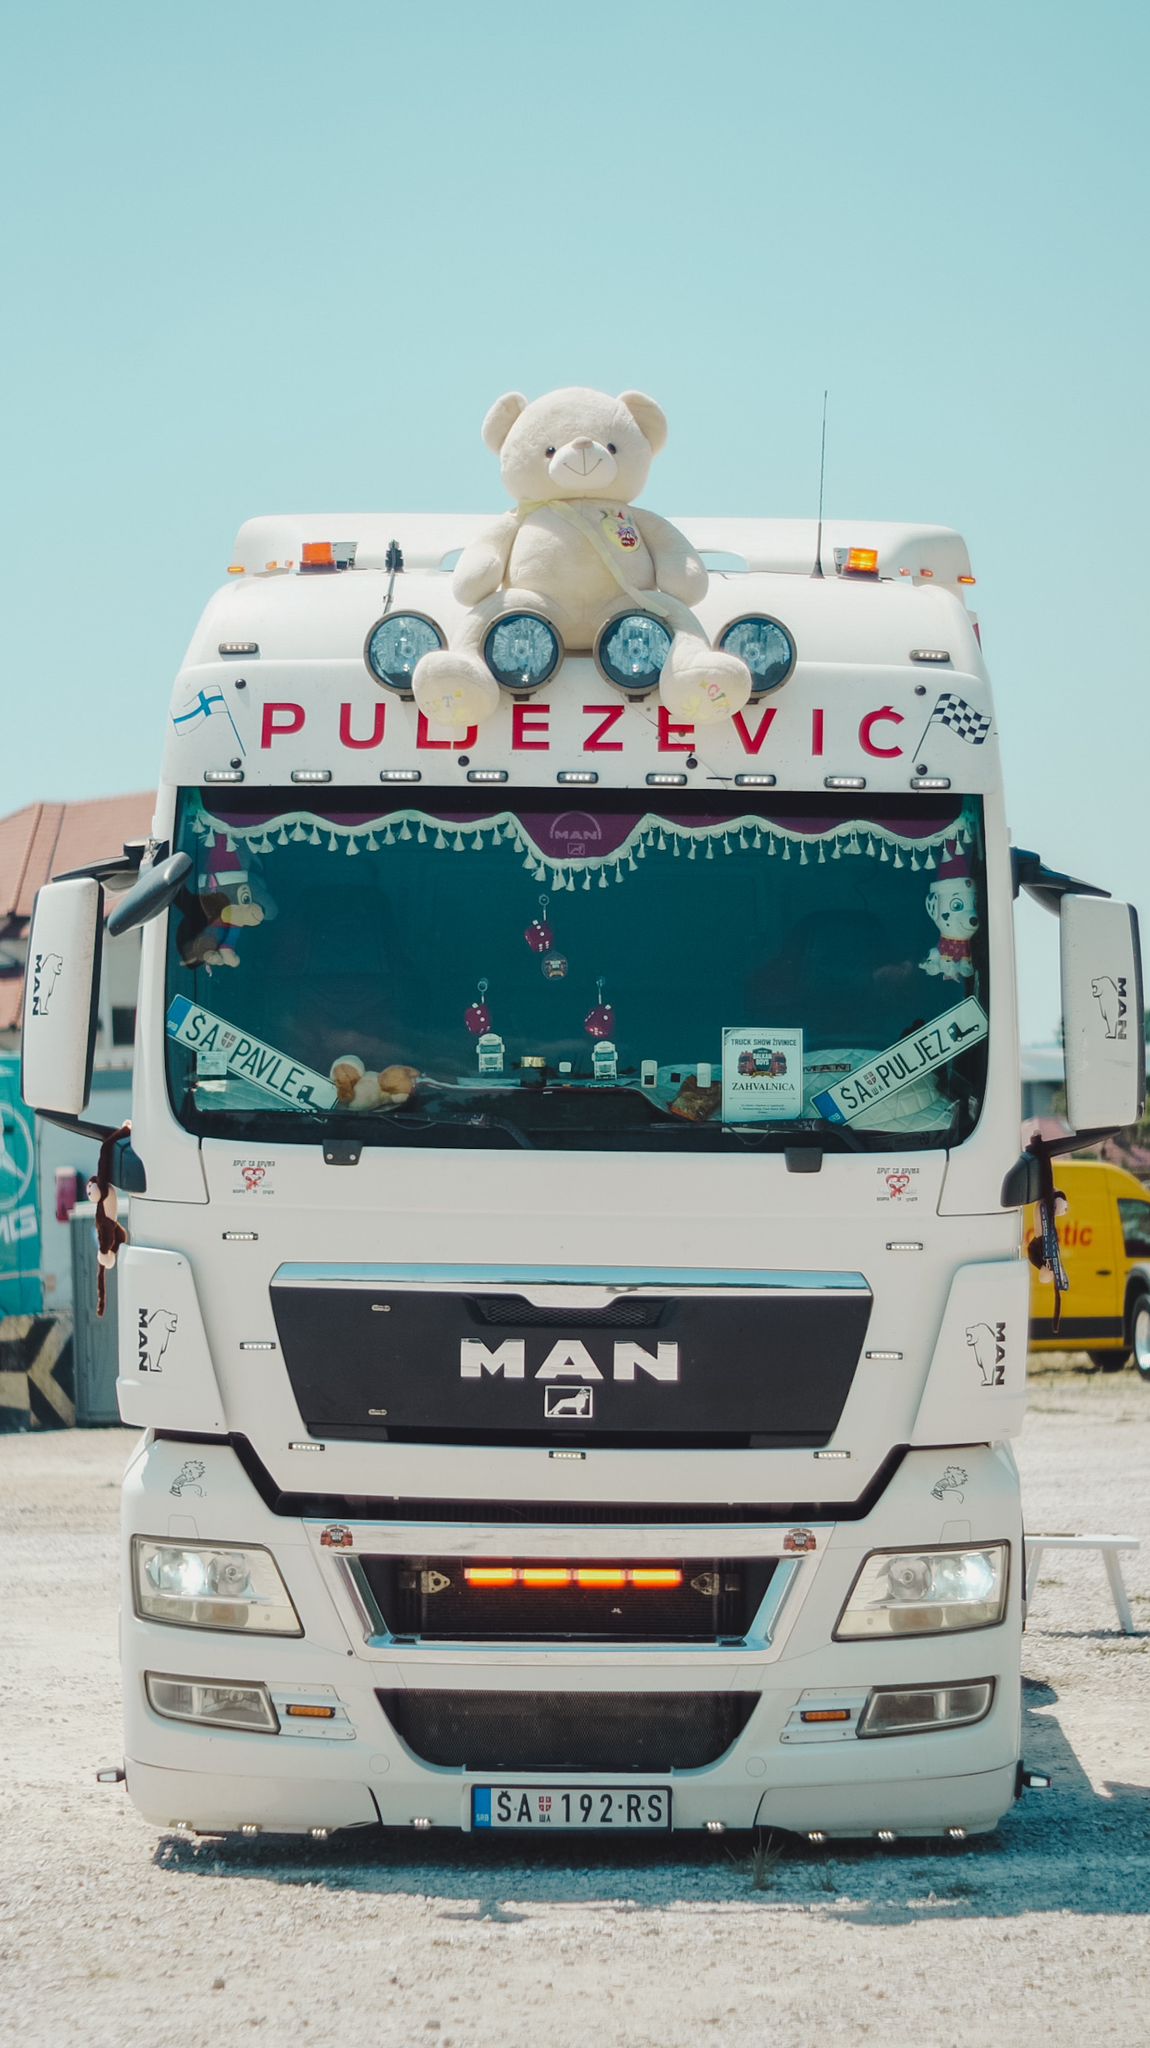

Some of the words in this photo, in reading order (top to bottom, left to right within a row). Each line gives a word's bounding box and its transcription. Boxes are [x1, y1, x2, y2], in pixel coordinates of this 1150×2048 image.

[554, 830, 598, 840] MAN
[32, 954, 43, 1015] MAN
[1117, 977, 1127, 1040] MAN
[228, 1038, 305, 1098] PAVLE
[731, 1082, 795, 1091] ZAHVALNICA
[875, 1029, 951, 1088] PULJEZ
[138, 1307, 149, 1372] MAN
[460, 1338, 678, 1381] MAN
[994, 1321, 1006, 1386] MAN
